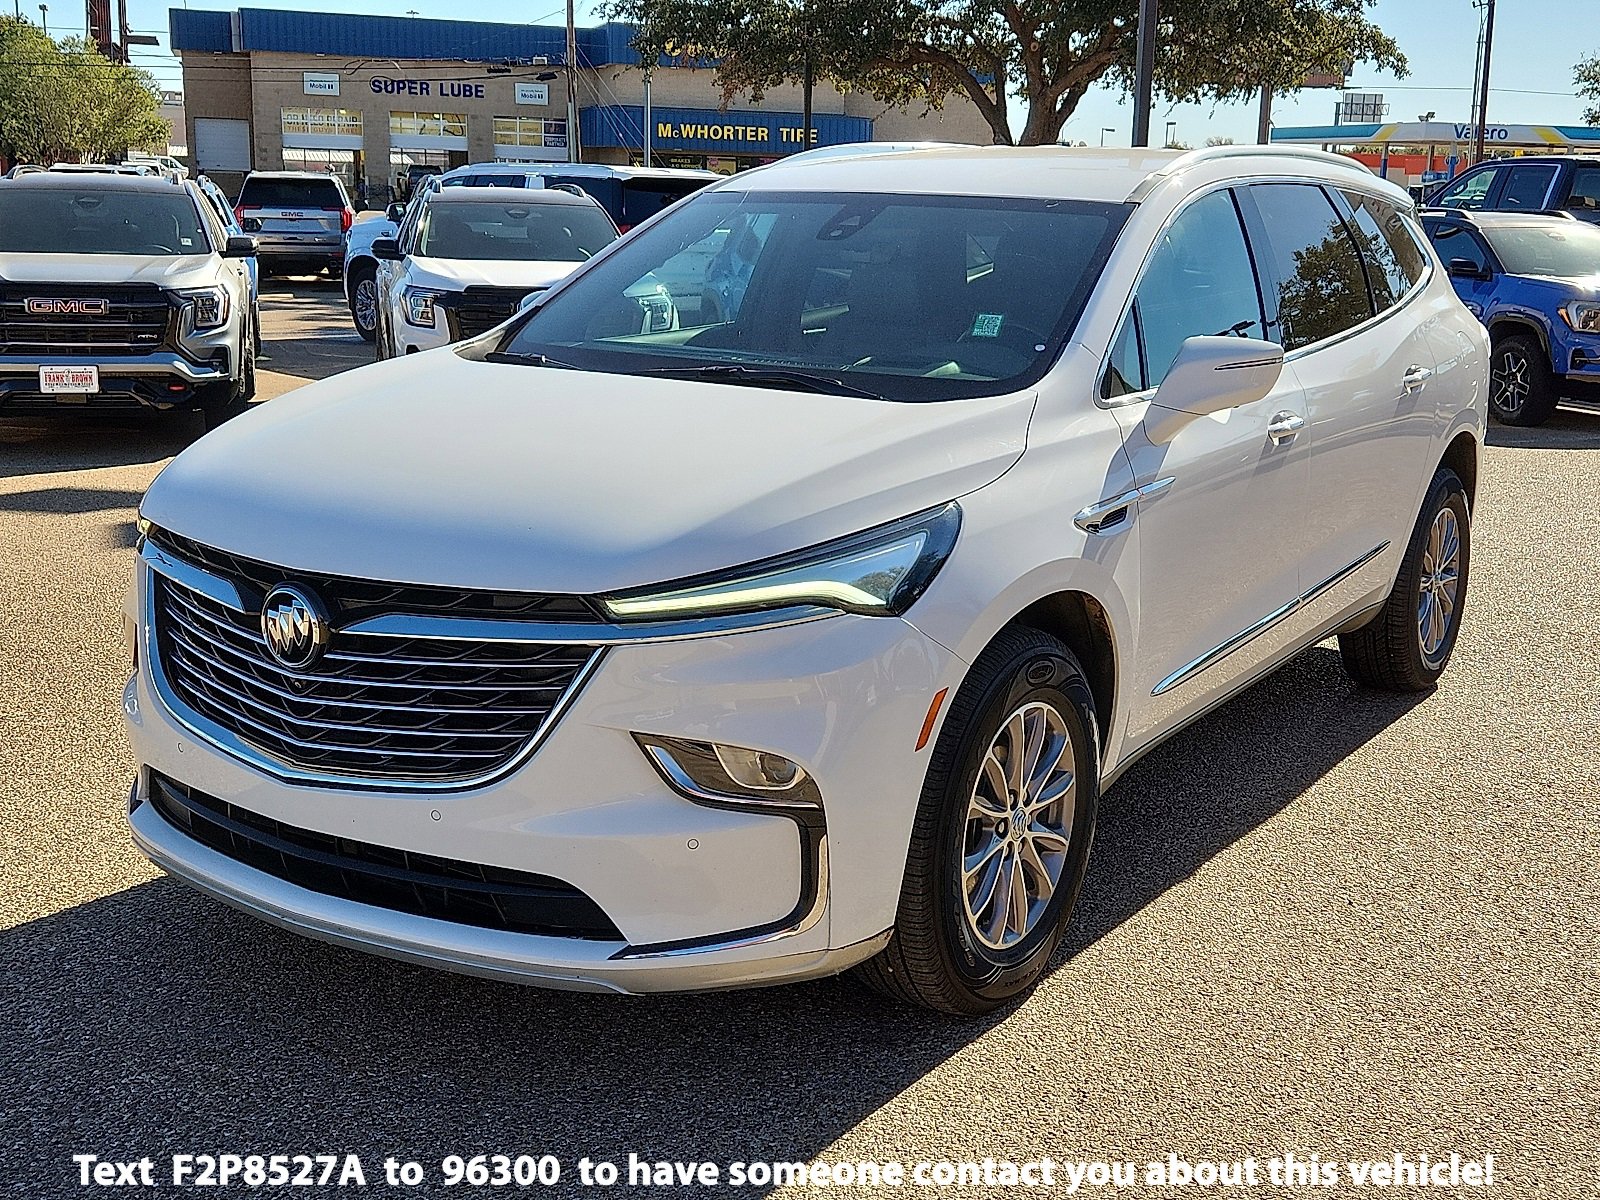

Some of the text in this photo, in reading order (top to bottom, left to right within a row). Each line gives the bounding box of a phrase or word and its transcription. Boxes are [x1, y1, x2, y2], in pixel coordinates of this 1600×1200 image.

[371, 79, 485, 99] SUPER LUBE
[657, 123, 818, 143] McWHORTER TIRE
[1454, 124, 1509, 140] Valero
[29, 299, 103, 313] GMC
[44, 373, 93, 383] FRANK BROWN
